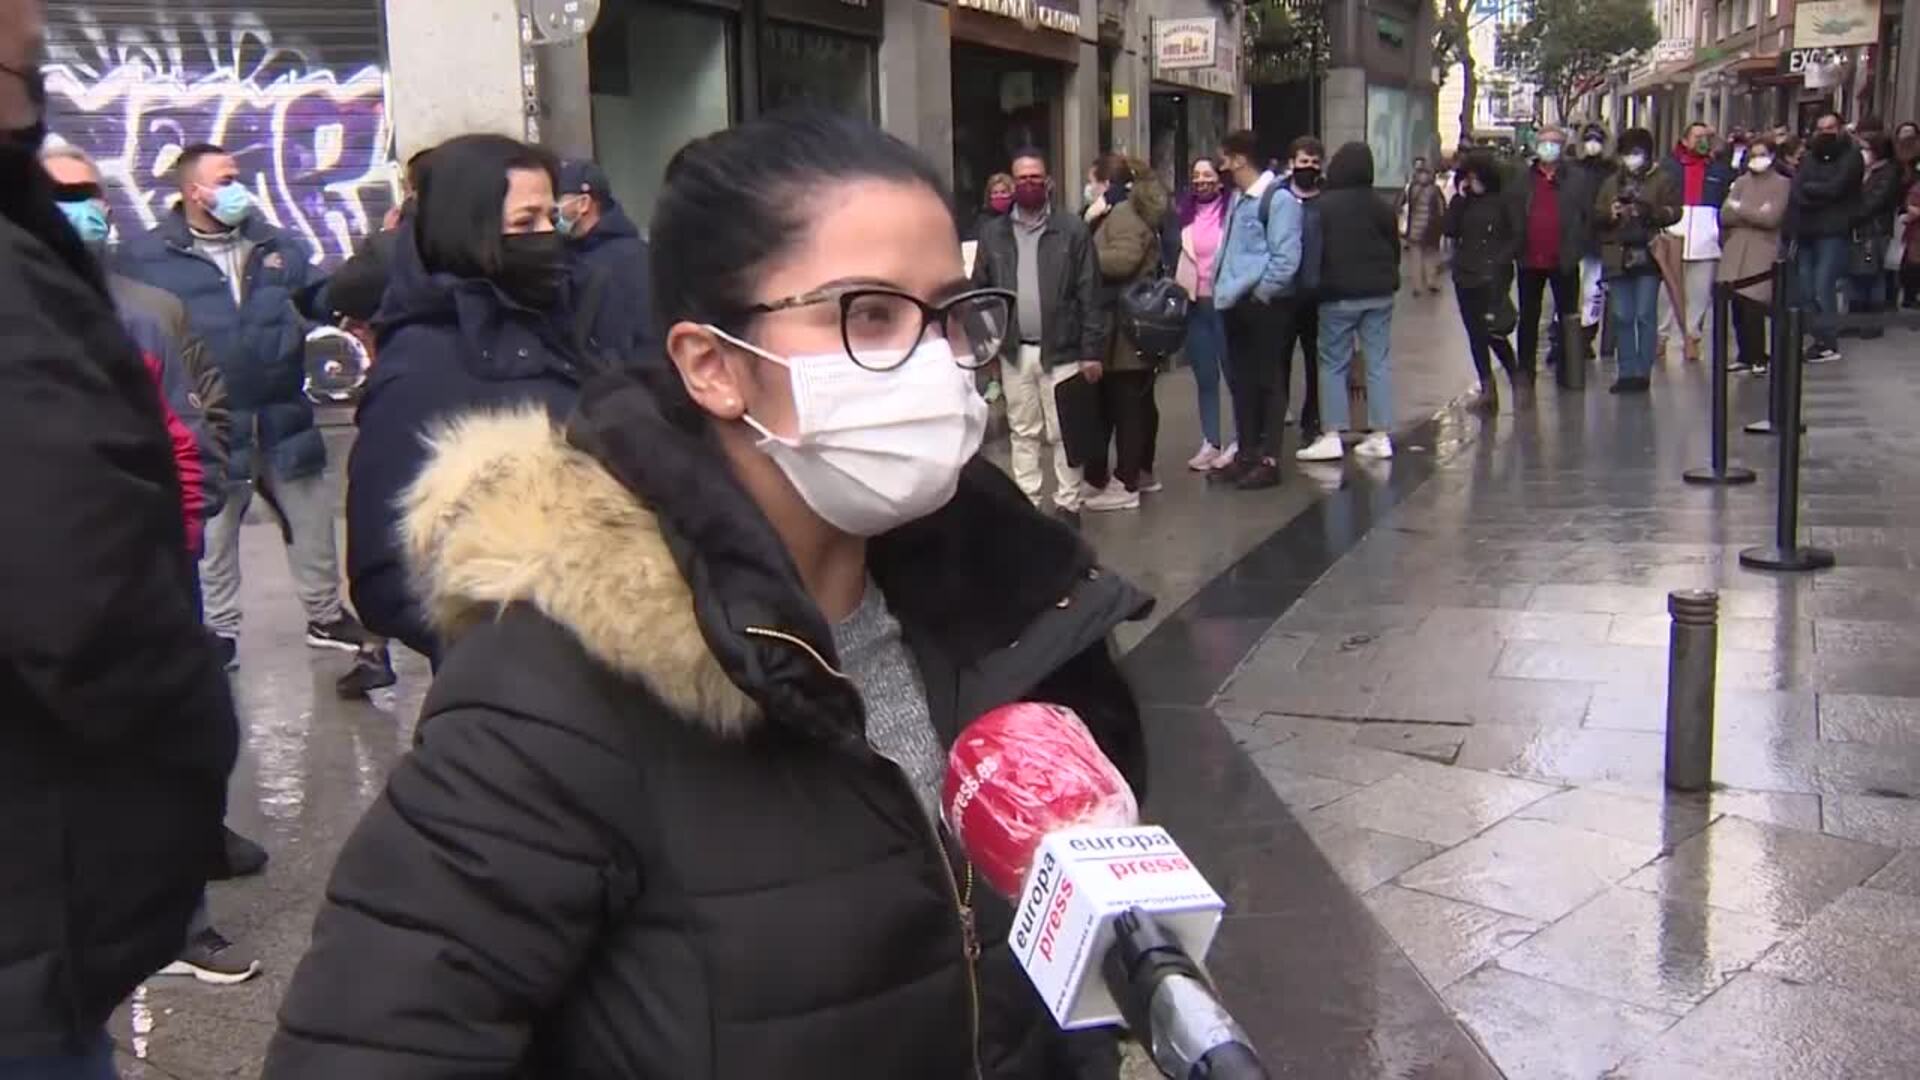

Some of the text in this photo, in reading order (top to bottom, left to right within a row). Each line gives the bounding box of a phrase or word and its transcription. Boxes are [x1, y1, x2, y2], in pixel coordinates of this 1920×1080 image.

[1069, 833, 1171, 851] europa
[1108, 857, 1190, 880] press
[1015, 852, 1056, 949] europa
[1038, 878, 1074, 962] press
